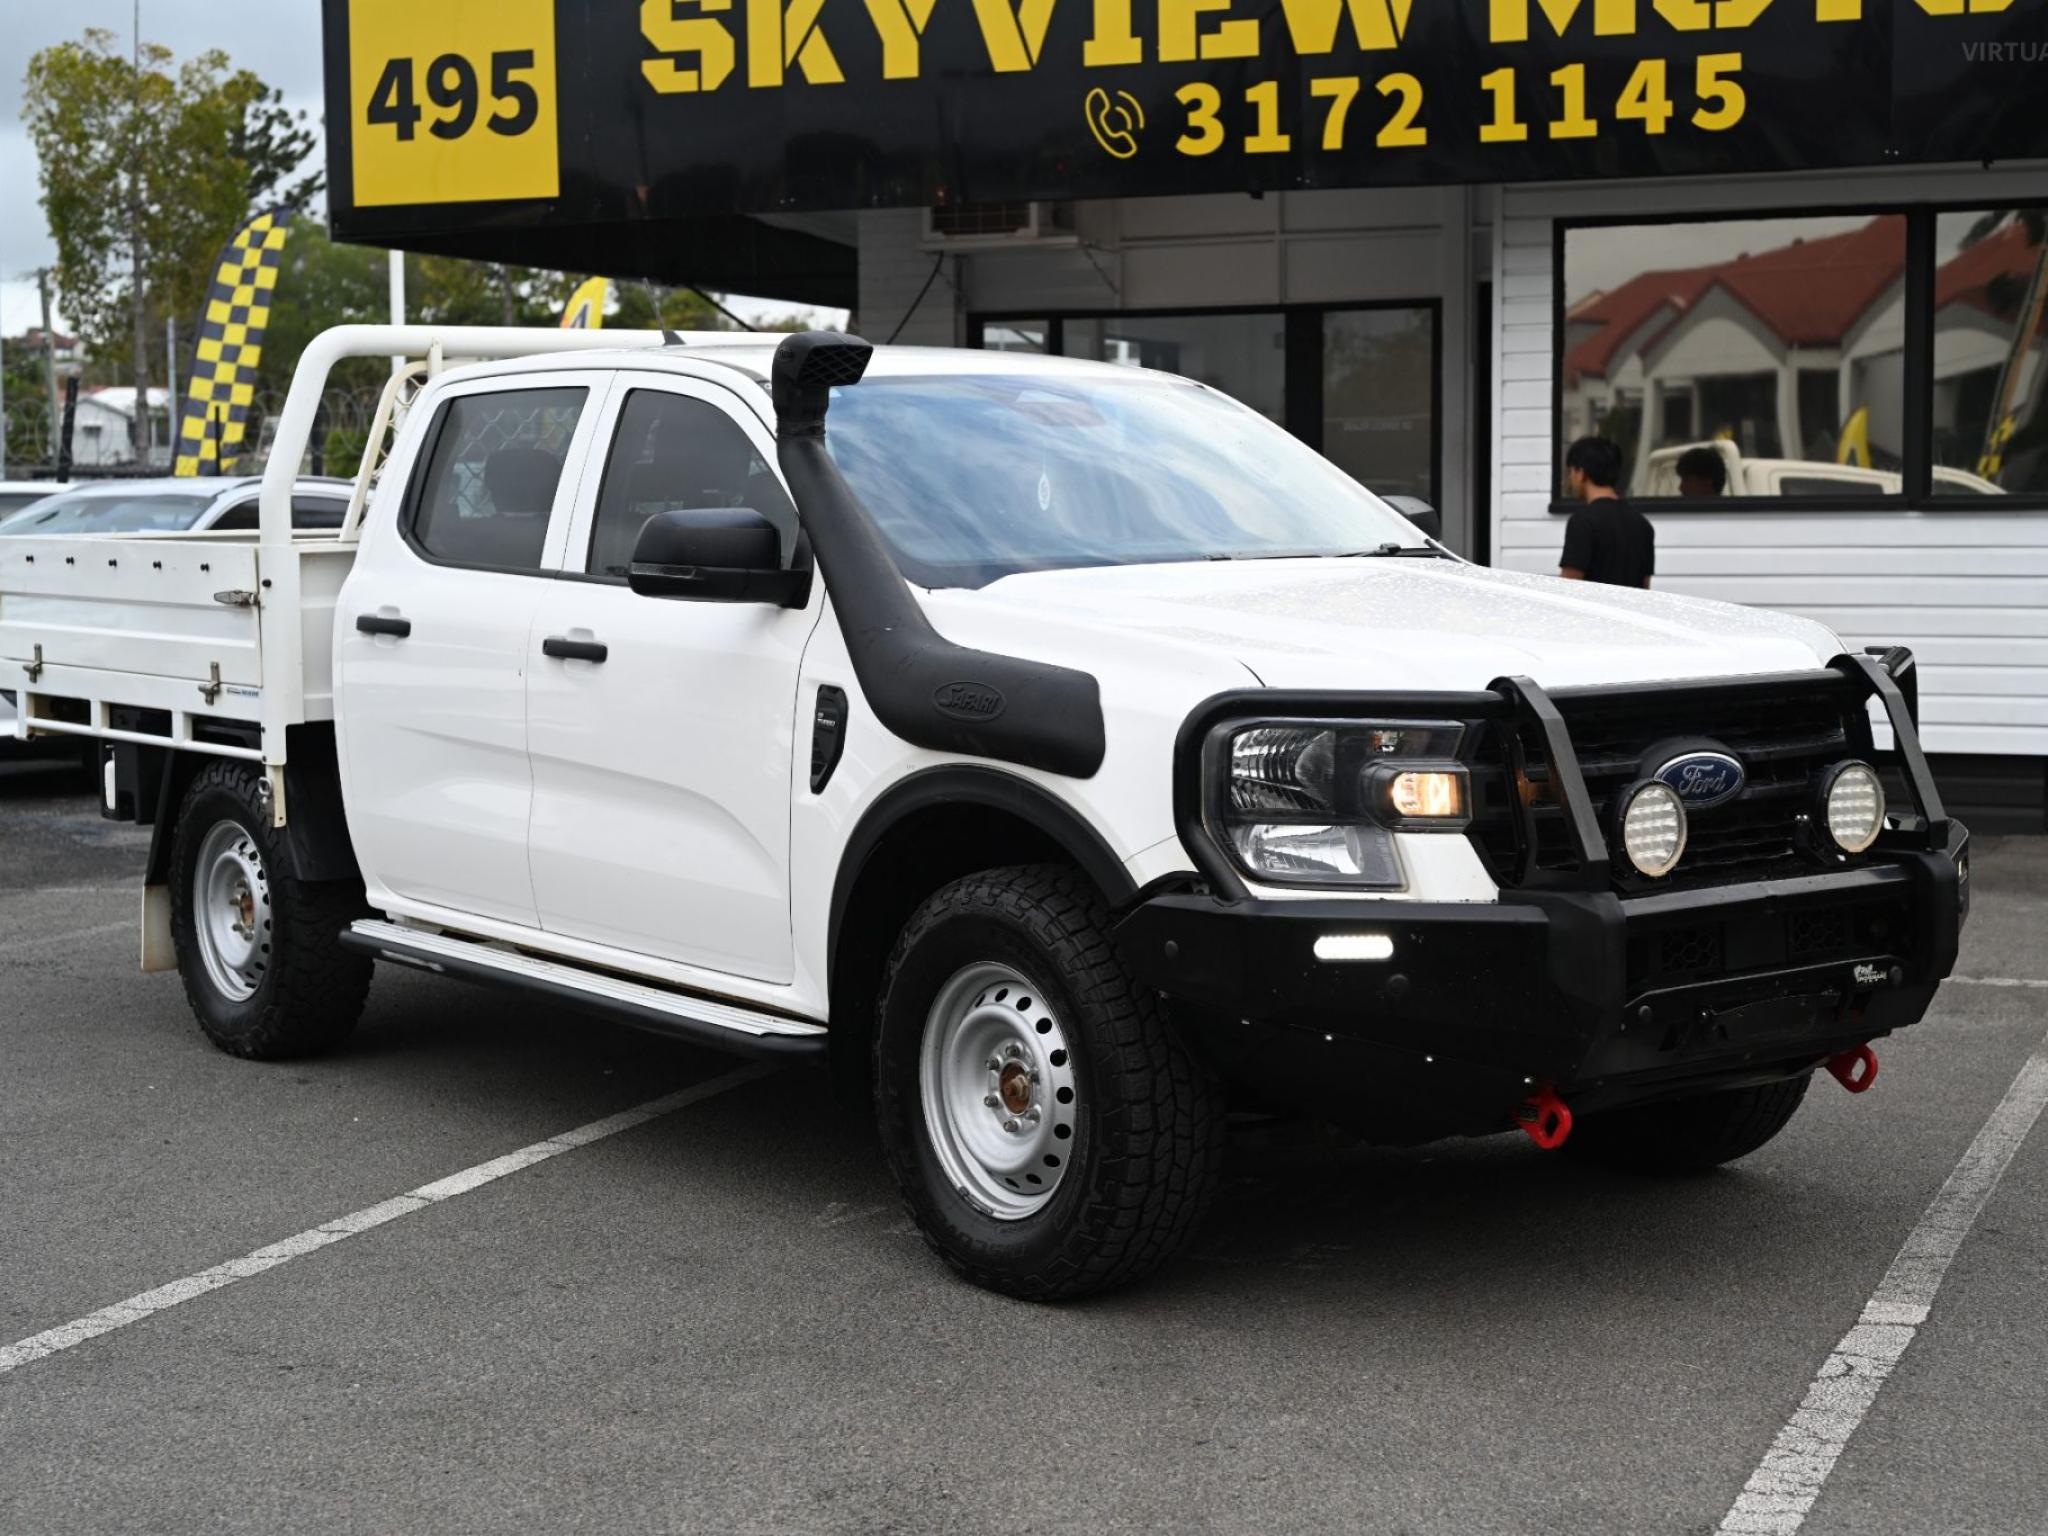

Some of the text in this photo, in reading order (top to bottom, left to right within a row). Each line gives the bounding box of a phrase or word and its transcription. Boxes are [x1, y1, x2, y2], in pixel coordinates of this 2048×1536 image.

[366, 49, 539, 142] 495
[1176, 52, 1746, 157] 3172 1145
[938, 685, 1000, 714] SAFARI
[1679, 763, 1726, 795] Ford
